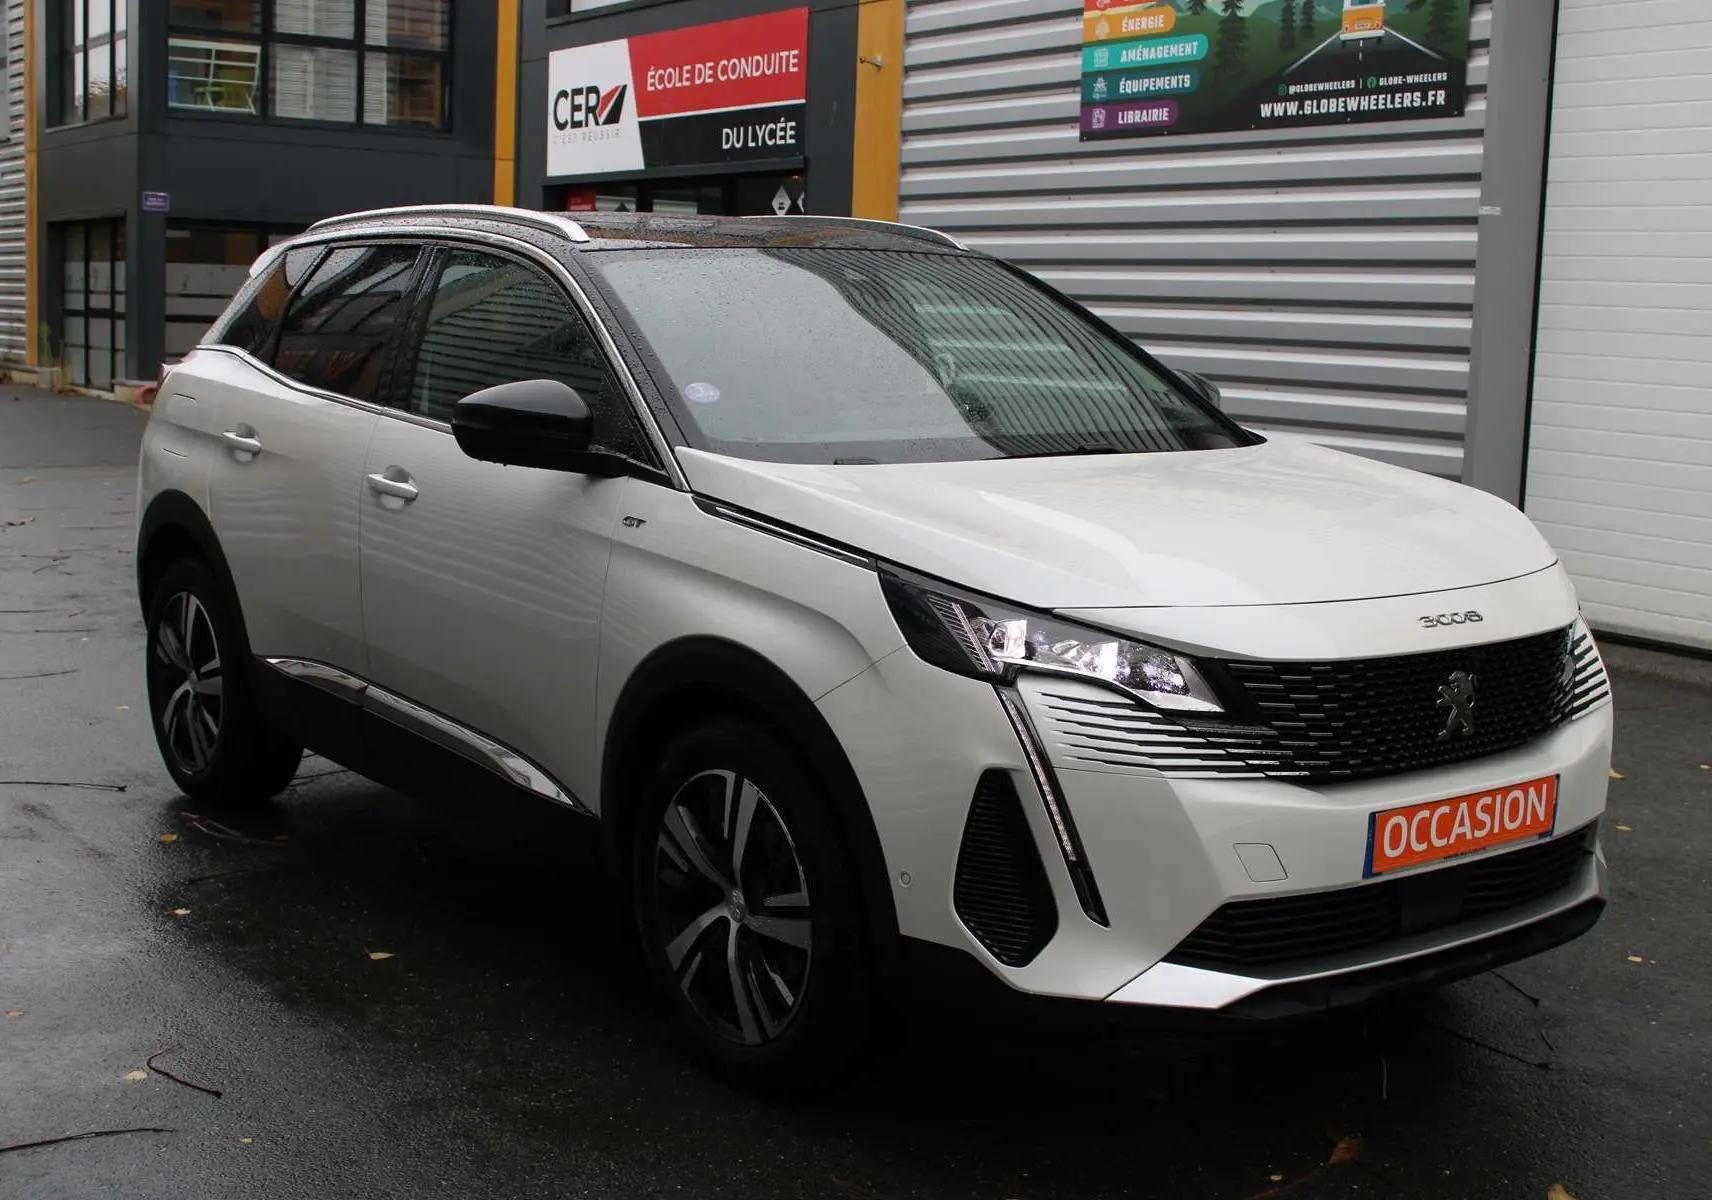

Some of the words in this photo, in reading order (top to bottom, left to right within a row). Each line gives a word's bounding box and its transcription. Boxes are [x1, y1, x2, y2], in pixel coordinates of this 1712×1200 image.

[1122, 15, 1164, 32] ÉNERGIE
[1120, 42, 1198, 63] AMÉNAGEMENT
[647, 66, 691, 91] ÉCOLE
[694, 63, 713, 84] DE
[717, 50, 799, 81] CONDUITE
[1379, 72, 1447, 86] GLOBE-WHEELERS
[1119, 74, 1190, 94] ÉQUIPEMENTS
[553, 85, 601, 131] CER
[1260, 90, 1446, 118] WWW.GLOBEWHEELERS.FR
[1118, 108, 1169, 124] LIBRAIRIE
[722, 127, 743, 149] DU
[747, 117, 796, 147] LYCÉE
[622, 516, 646, 528] GT
[1418, 610, 1483, 628] 3008
[1383, 783, 1548, 858] OCCASION
